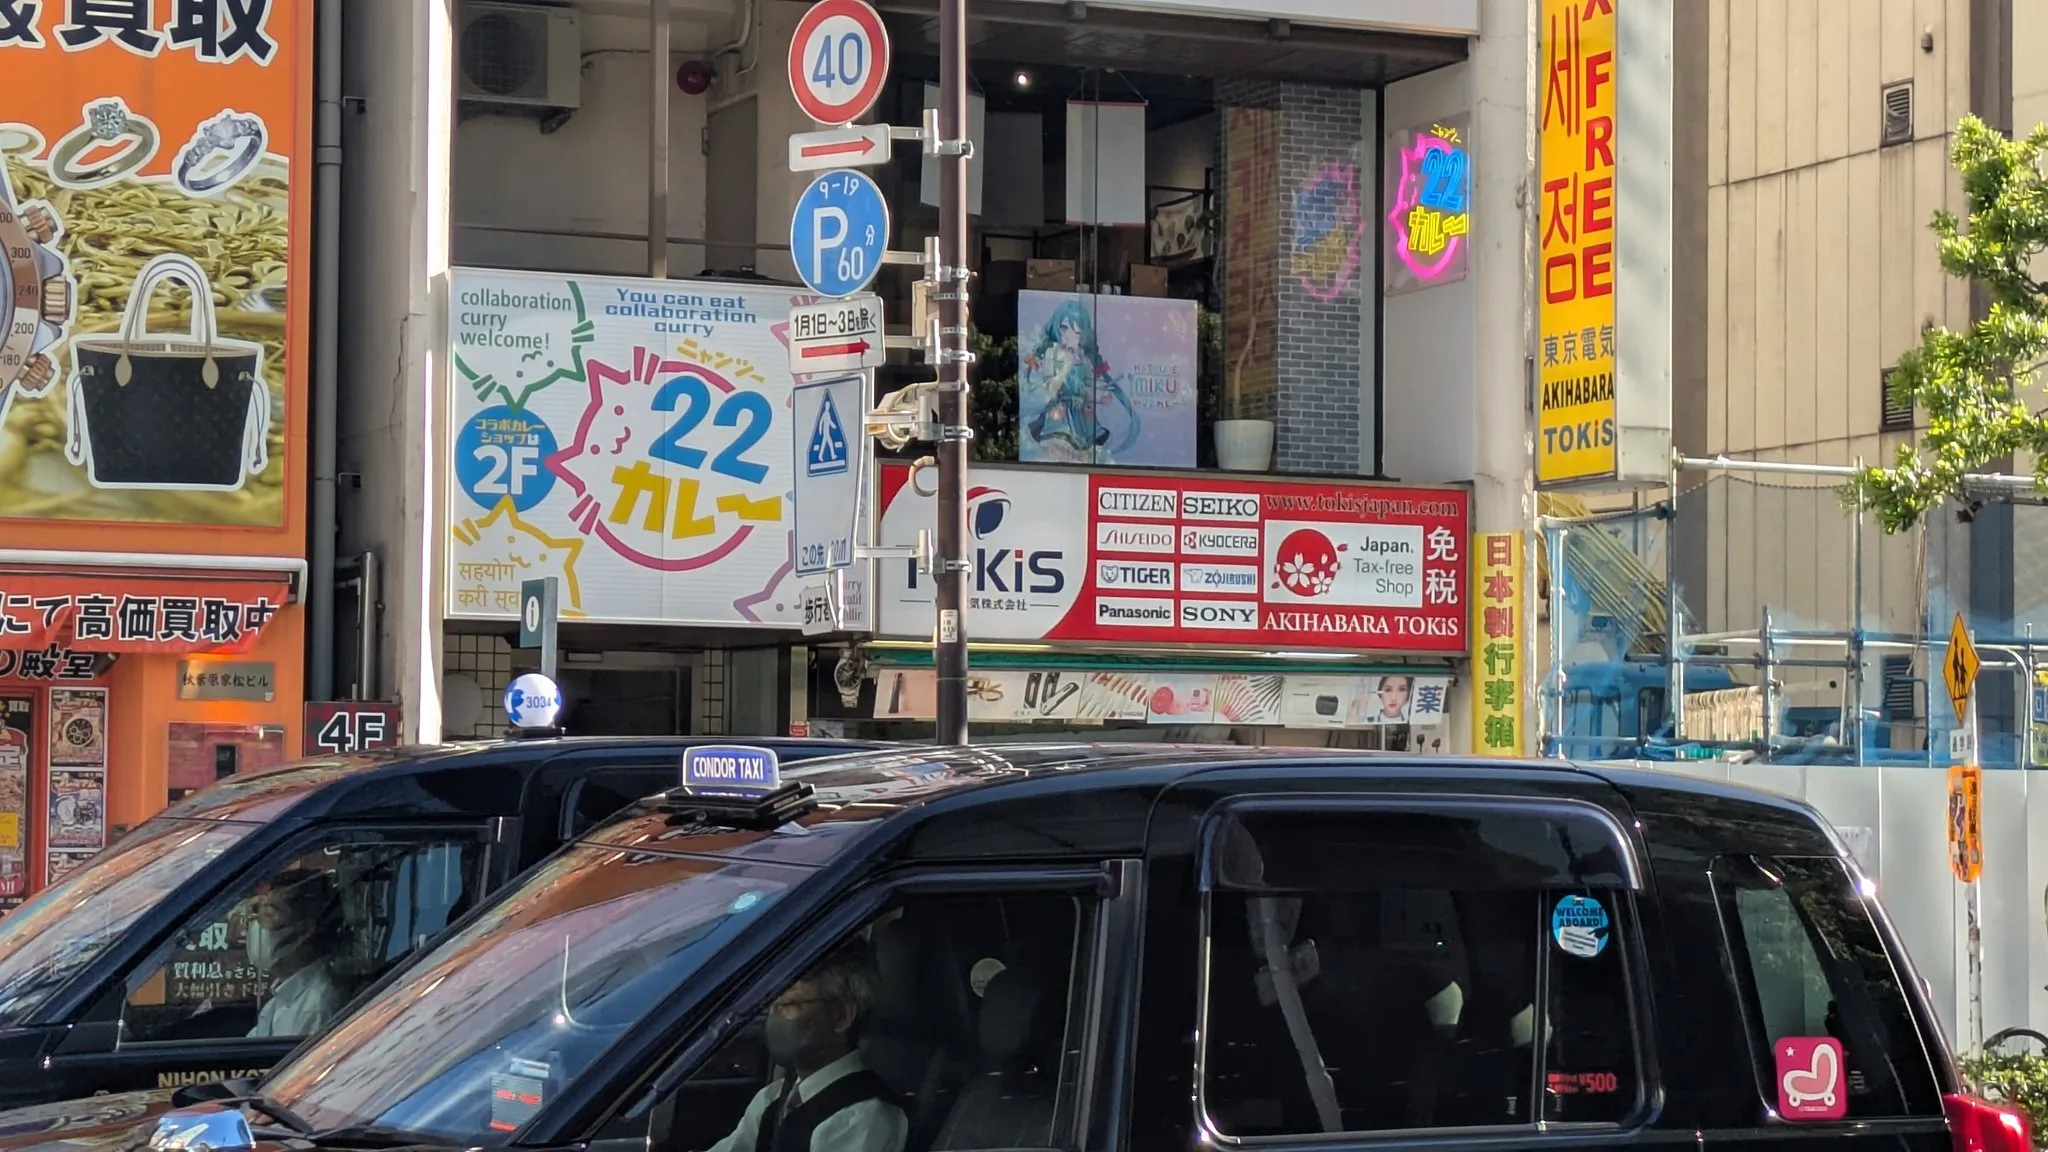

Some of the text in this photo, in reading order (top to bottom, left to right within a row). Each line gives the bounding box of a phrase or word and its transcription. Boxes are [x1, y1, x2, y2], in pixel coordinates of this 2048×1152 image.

[811, 32, 863, 88] 40
[1420, 147, 1465, 211] 22
[1583, 50, 1614, 300] FREE
[819, 176, 860, 200] 9-19
[1408, 206, 1469, 256] カレー
[11, 247, 31, 259] 300
[813, 206, 864, 285] P 60
[18, 284, 39, 297] 240
[460, 287, 572, 311] collaboration
[617, 288, 747, 309] You can eat
[460, 312, 507, 332] curry
[605, 304, 756, 323] collaboration
[14, 321, 34, 335] 200
[654, 322, 714, 337] curry
[460, 328, 549, 350] welcome!
[1543, 323, 1614, 368] 東京電気
[3, 354, 21, 366] 180
[1542, 371, 1614, 412] AKIHABARA
[475, 418, 546, 432] コラボカレー
[648, 376, 773, 484] 22
[481, 431, 539, 446] ショップは
[473, 445, 539, 495] 2F
[608, 460, 782, 539] カレー
[1099, 491, 1176, 513] CITIZEN
[1183, 496, 1258, 516] SEIKO
[1264, 492, 1459, 519] www.tokisjapan.com
[1101, 529, 1172, 546] SHISEIDO
[1199, 534, 1257, 549] KYOCERA
[1360, 536, 1414, 555] Japan.
[1119, 566, 1171, 585] TIGER
[1353, 558, 1414, 575] Tax-free
[1425, 525, 1459, 606] 免税
[1204, 569, 1256, 588] ZOJIRUSHI
[1375, 578, 1414, 597] Shop
[1099, 603, 1171, 620] Panasonic
[1182, 606, 1256, 622] SONY
[1263, 612, 1459, 637] AKIHABARA TOKiS
[1484, 535, 1515, 749] 日本製行李箱
[526, 695, 552, 709] 3034
[1415, 685, 1443, 713] 薬
[318, 711, 386, 754] 4F
[693, 757, 764, 780] CONDOR TAXI
[1556, 907, 1603, 917] WELCOME
[158, 1070, 225, 1088] NIHON
